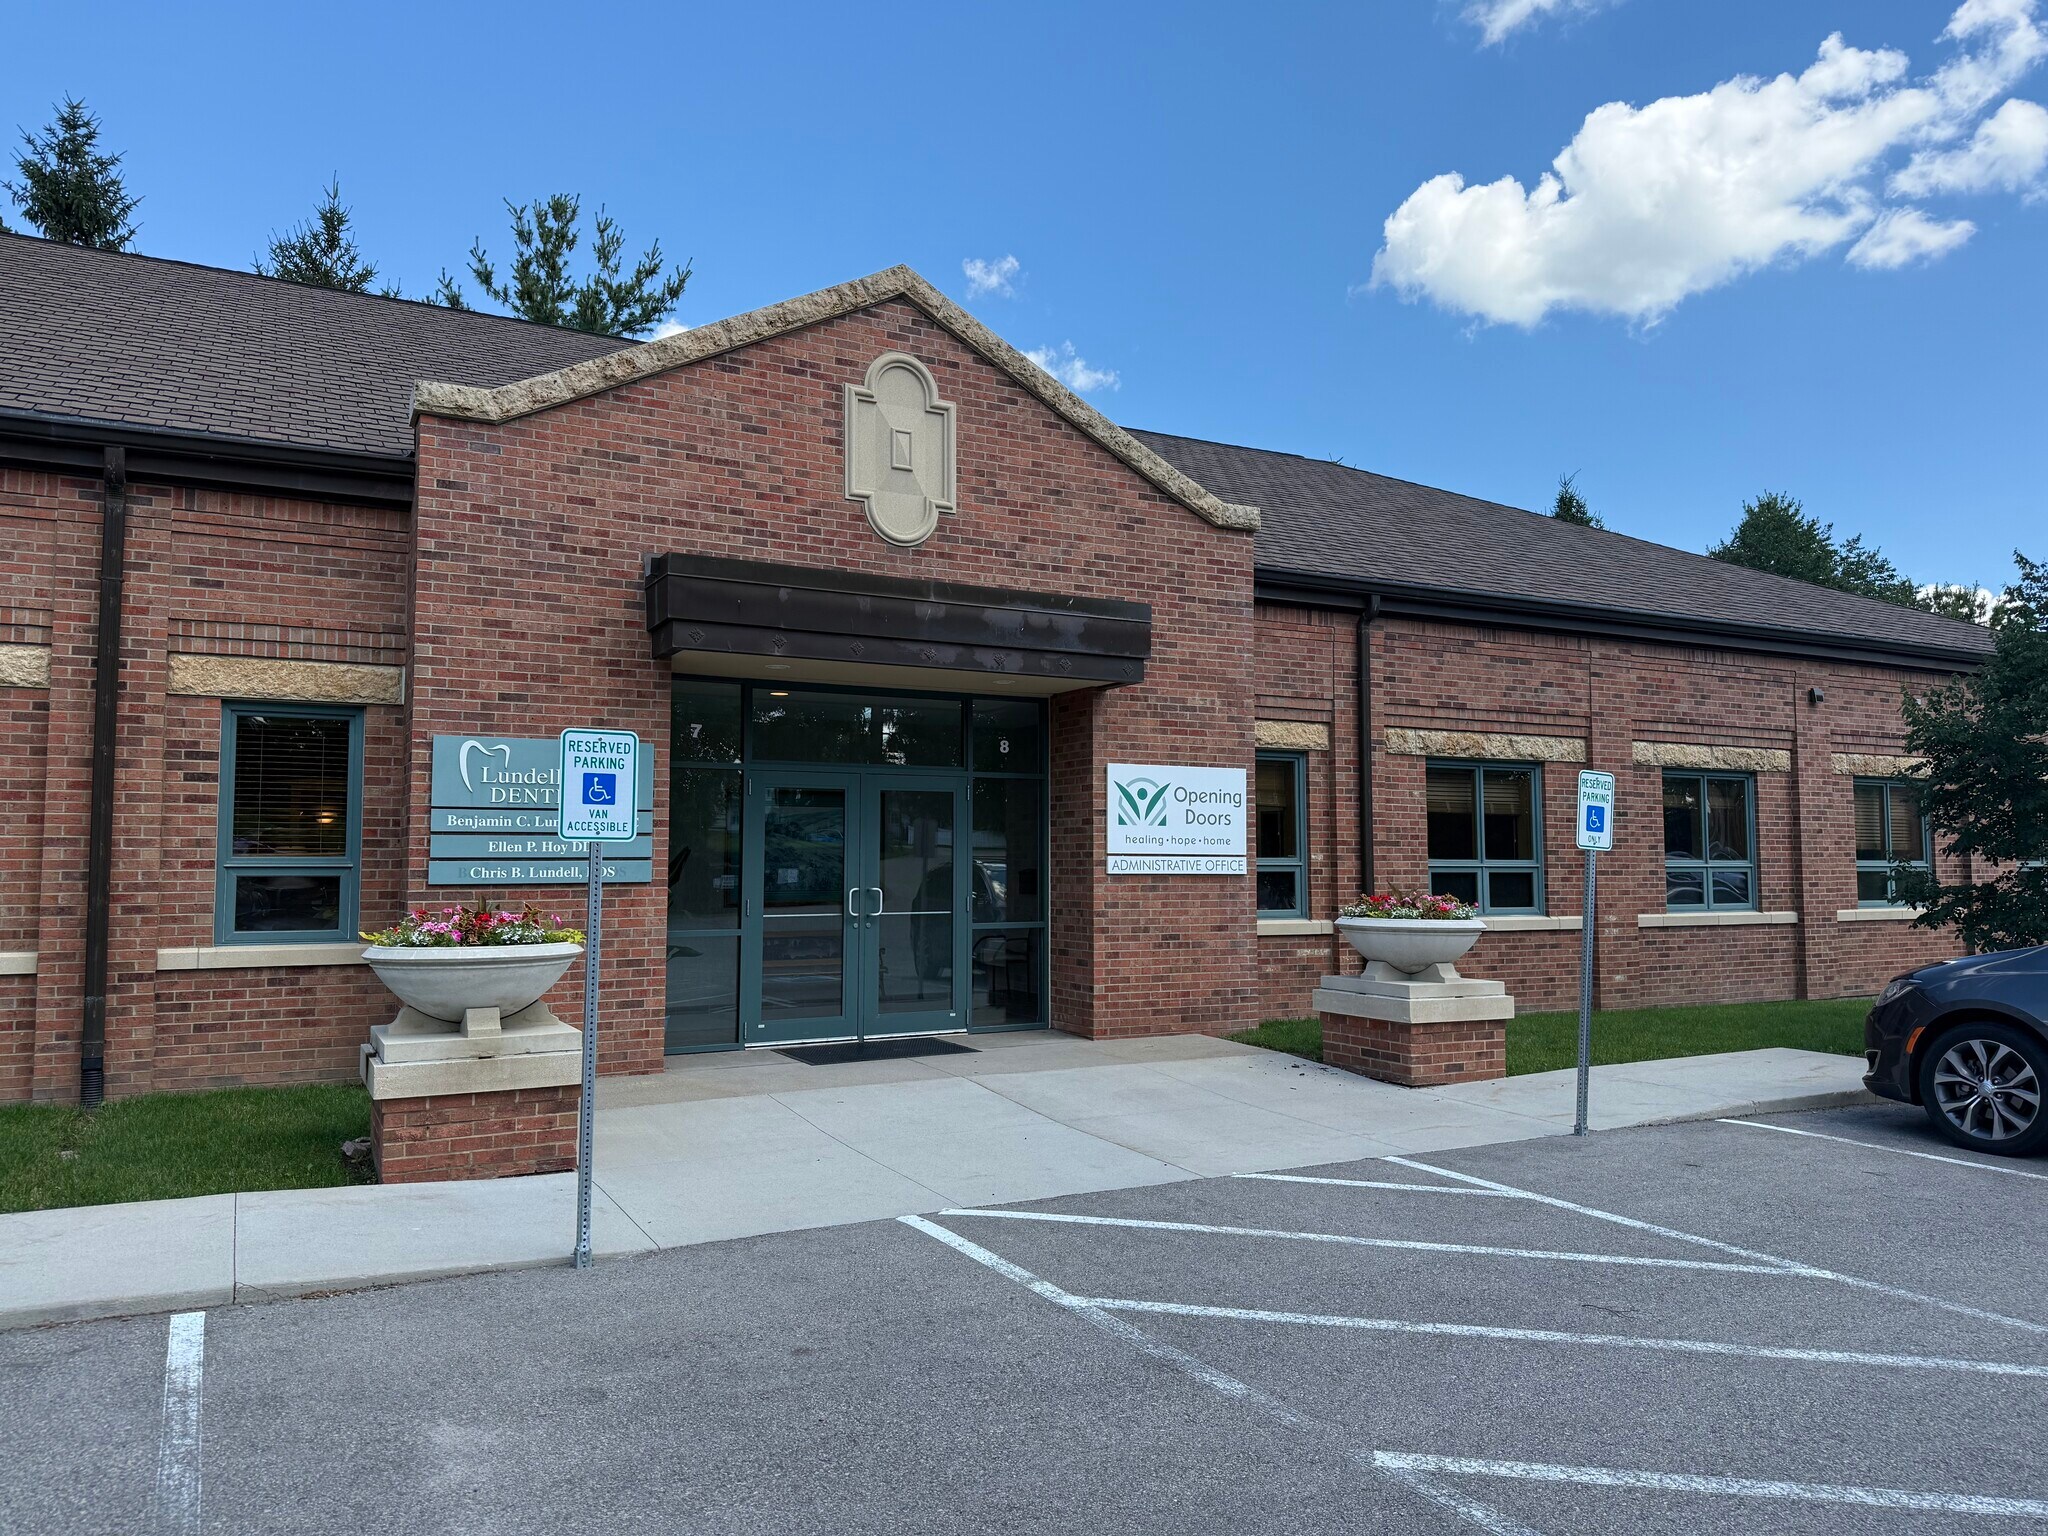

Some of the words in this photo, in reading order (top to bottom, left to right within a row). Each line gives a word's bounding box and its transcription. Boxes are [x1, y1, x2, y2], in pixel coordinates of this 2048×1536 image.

[690, 723, 703, 738] 7
[568, 740, 631, 755] RESERVED
[999, 740, 1010, 754] 8
[574, 756, 625, 770] PARKING
[1581, 778, 1612, 791] RESERVED
[1174, 786, 1242, 808] Opening
[1582, 791, 1610, 804] PARKING
[588, 809, 608, 819] VAN
[1186, 809, 1232, 826] Doors
[447, 814, 512, 830] Benjamin
[516, 815, 531, 827] C.
[567, 821, 628, 833] ACCESSIBLE
[1125, 834, 1164, 847] healing
[1171, 835, 1197, 847] hope
[1203, 836, 1231, 846] home
[1587, 834, 1601, 844] ONLY
[488, 840, 522, 853] Ellen
[527, 841, 538, 853] P.
[542, 841, 568, 855] Hoy
[1112, 859, 1202, 871] ADMINISTRATIVE
[1205, 859, 1244, 872] OFFICE
[470, 867, 507, 879] Chris
[511, 867, 525, 879] B.
[529, 867, 583, 880] Lundell,
